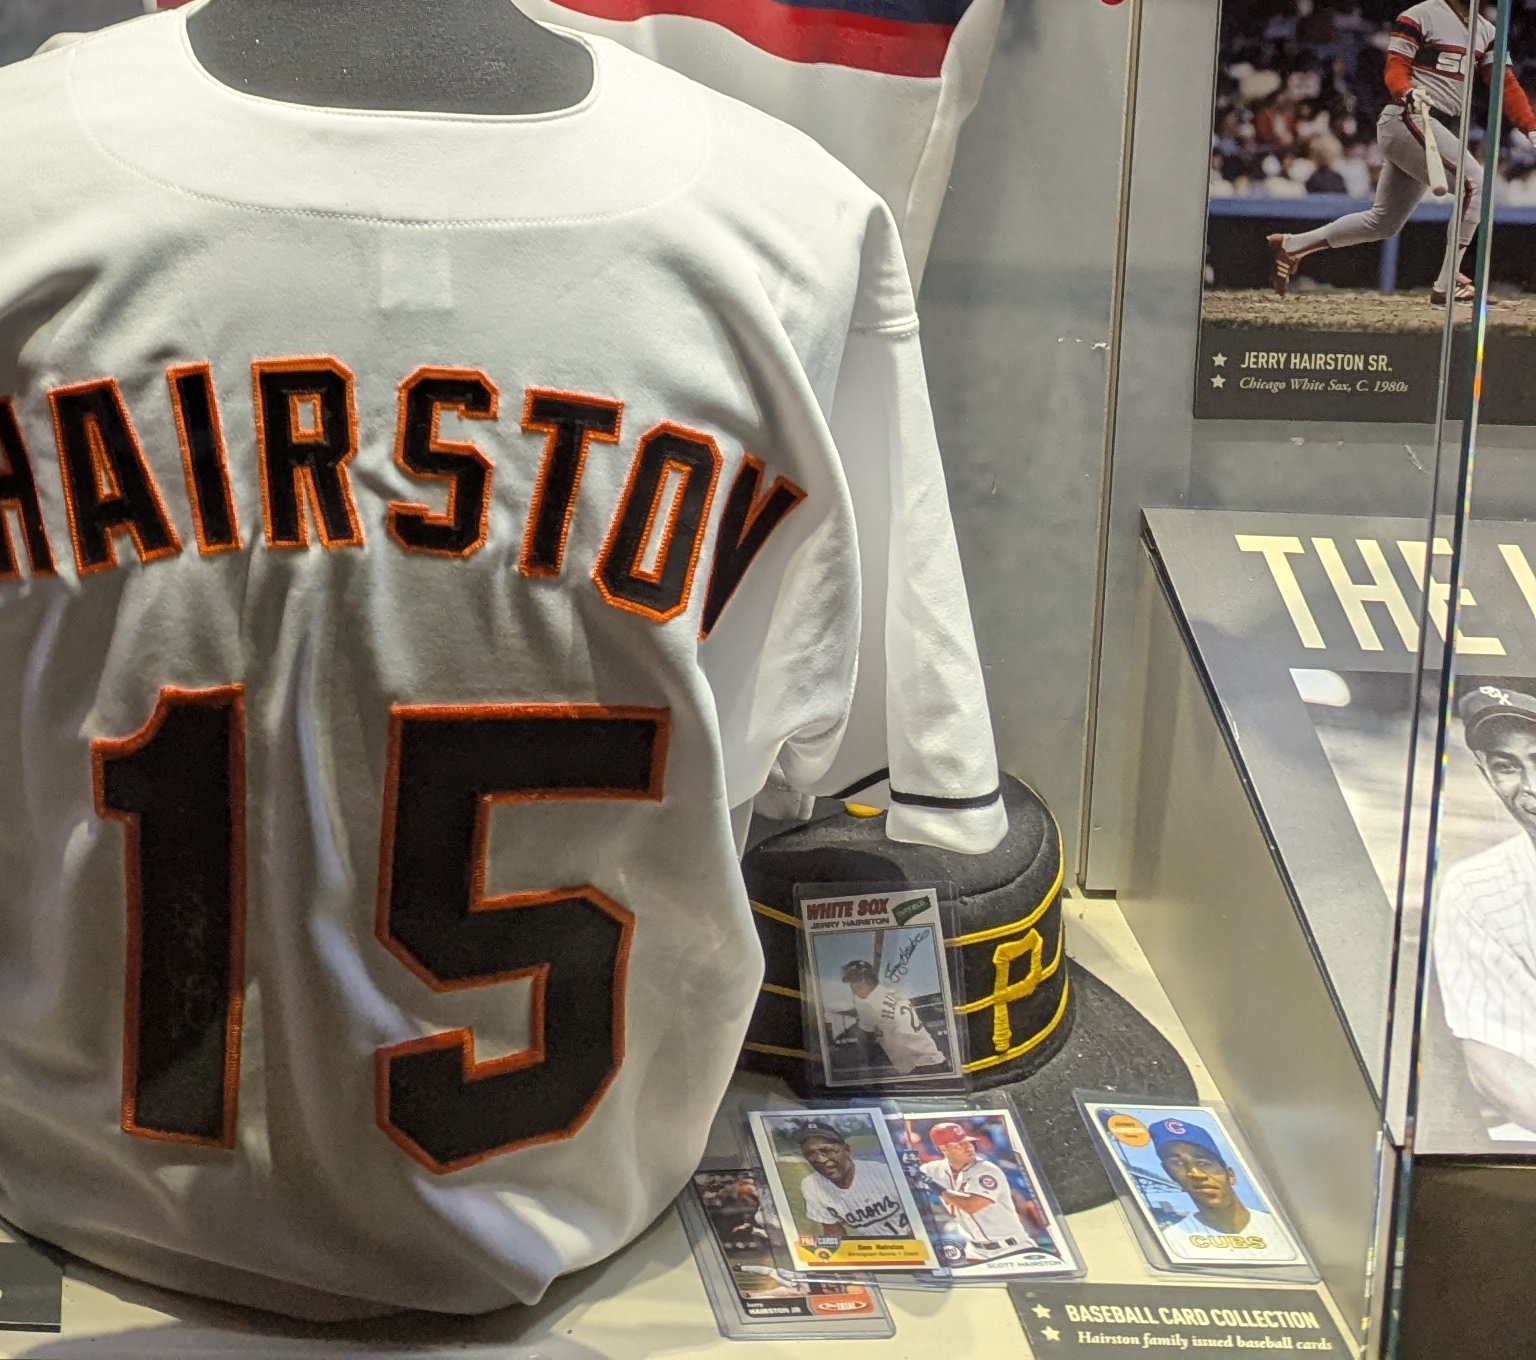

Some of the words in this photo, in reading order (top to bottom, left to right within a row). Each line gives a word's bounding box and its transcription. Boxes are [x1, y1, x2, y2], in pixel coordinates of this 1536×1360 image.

[1241, 351, 1287, 369] JERRY
[1290, 352, 1364, 371] HAIRSTON
[1368, 354, 1393, 372] SR.
[1240, 376, 1287, 393] Chicago
[1290, 377, 1325, 392] White
[1328, 378, 1352, 394] Sox,
[1355, 379, 1370, 392] C.
[1373, 379, 1408, 393] 1980s
[1235, 534, 1506, 656] THE
[806, 901, 854, 920] WHITE
[857, 898, 889, 917] SOX
[91, 684, 671, 1175] 15
[810, 921, 840, 929] JERRY
[992, 928, 1043, 1052] P
[1189, 1235, 1267, 1249] CUBS
[1065, 1305, 1159, 1325] BASEBALL
[1159, 1307, 1210, 1326] CARD
[1211, 1309, 1320, 1329] COLLECTION
[1078, 1331, 1139, 1346] Hairston
[1142, 1332, 1188, 1349] family
[1192, 1334, 1233, 1348] issued
[1236, 1334, 1293, 1350] baseball
[1296, 1338, 1332, 1351] cards
